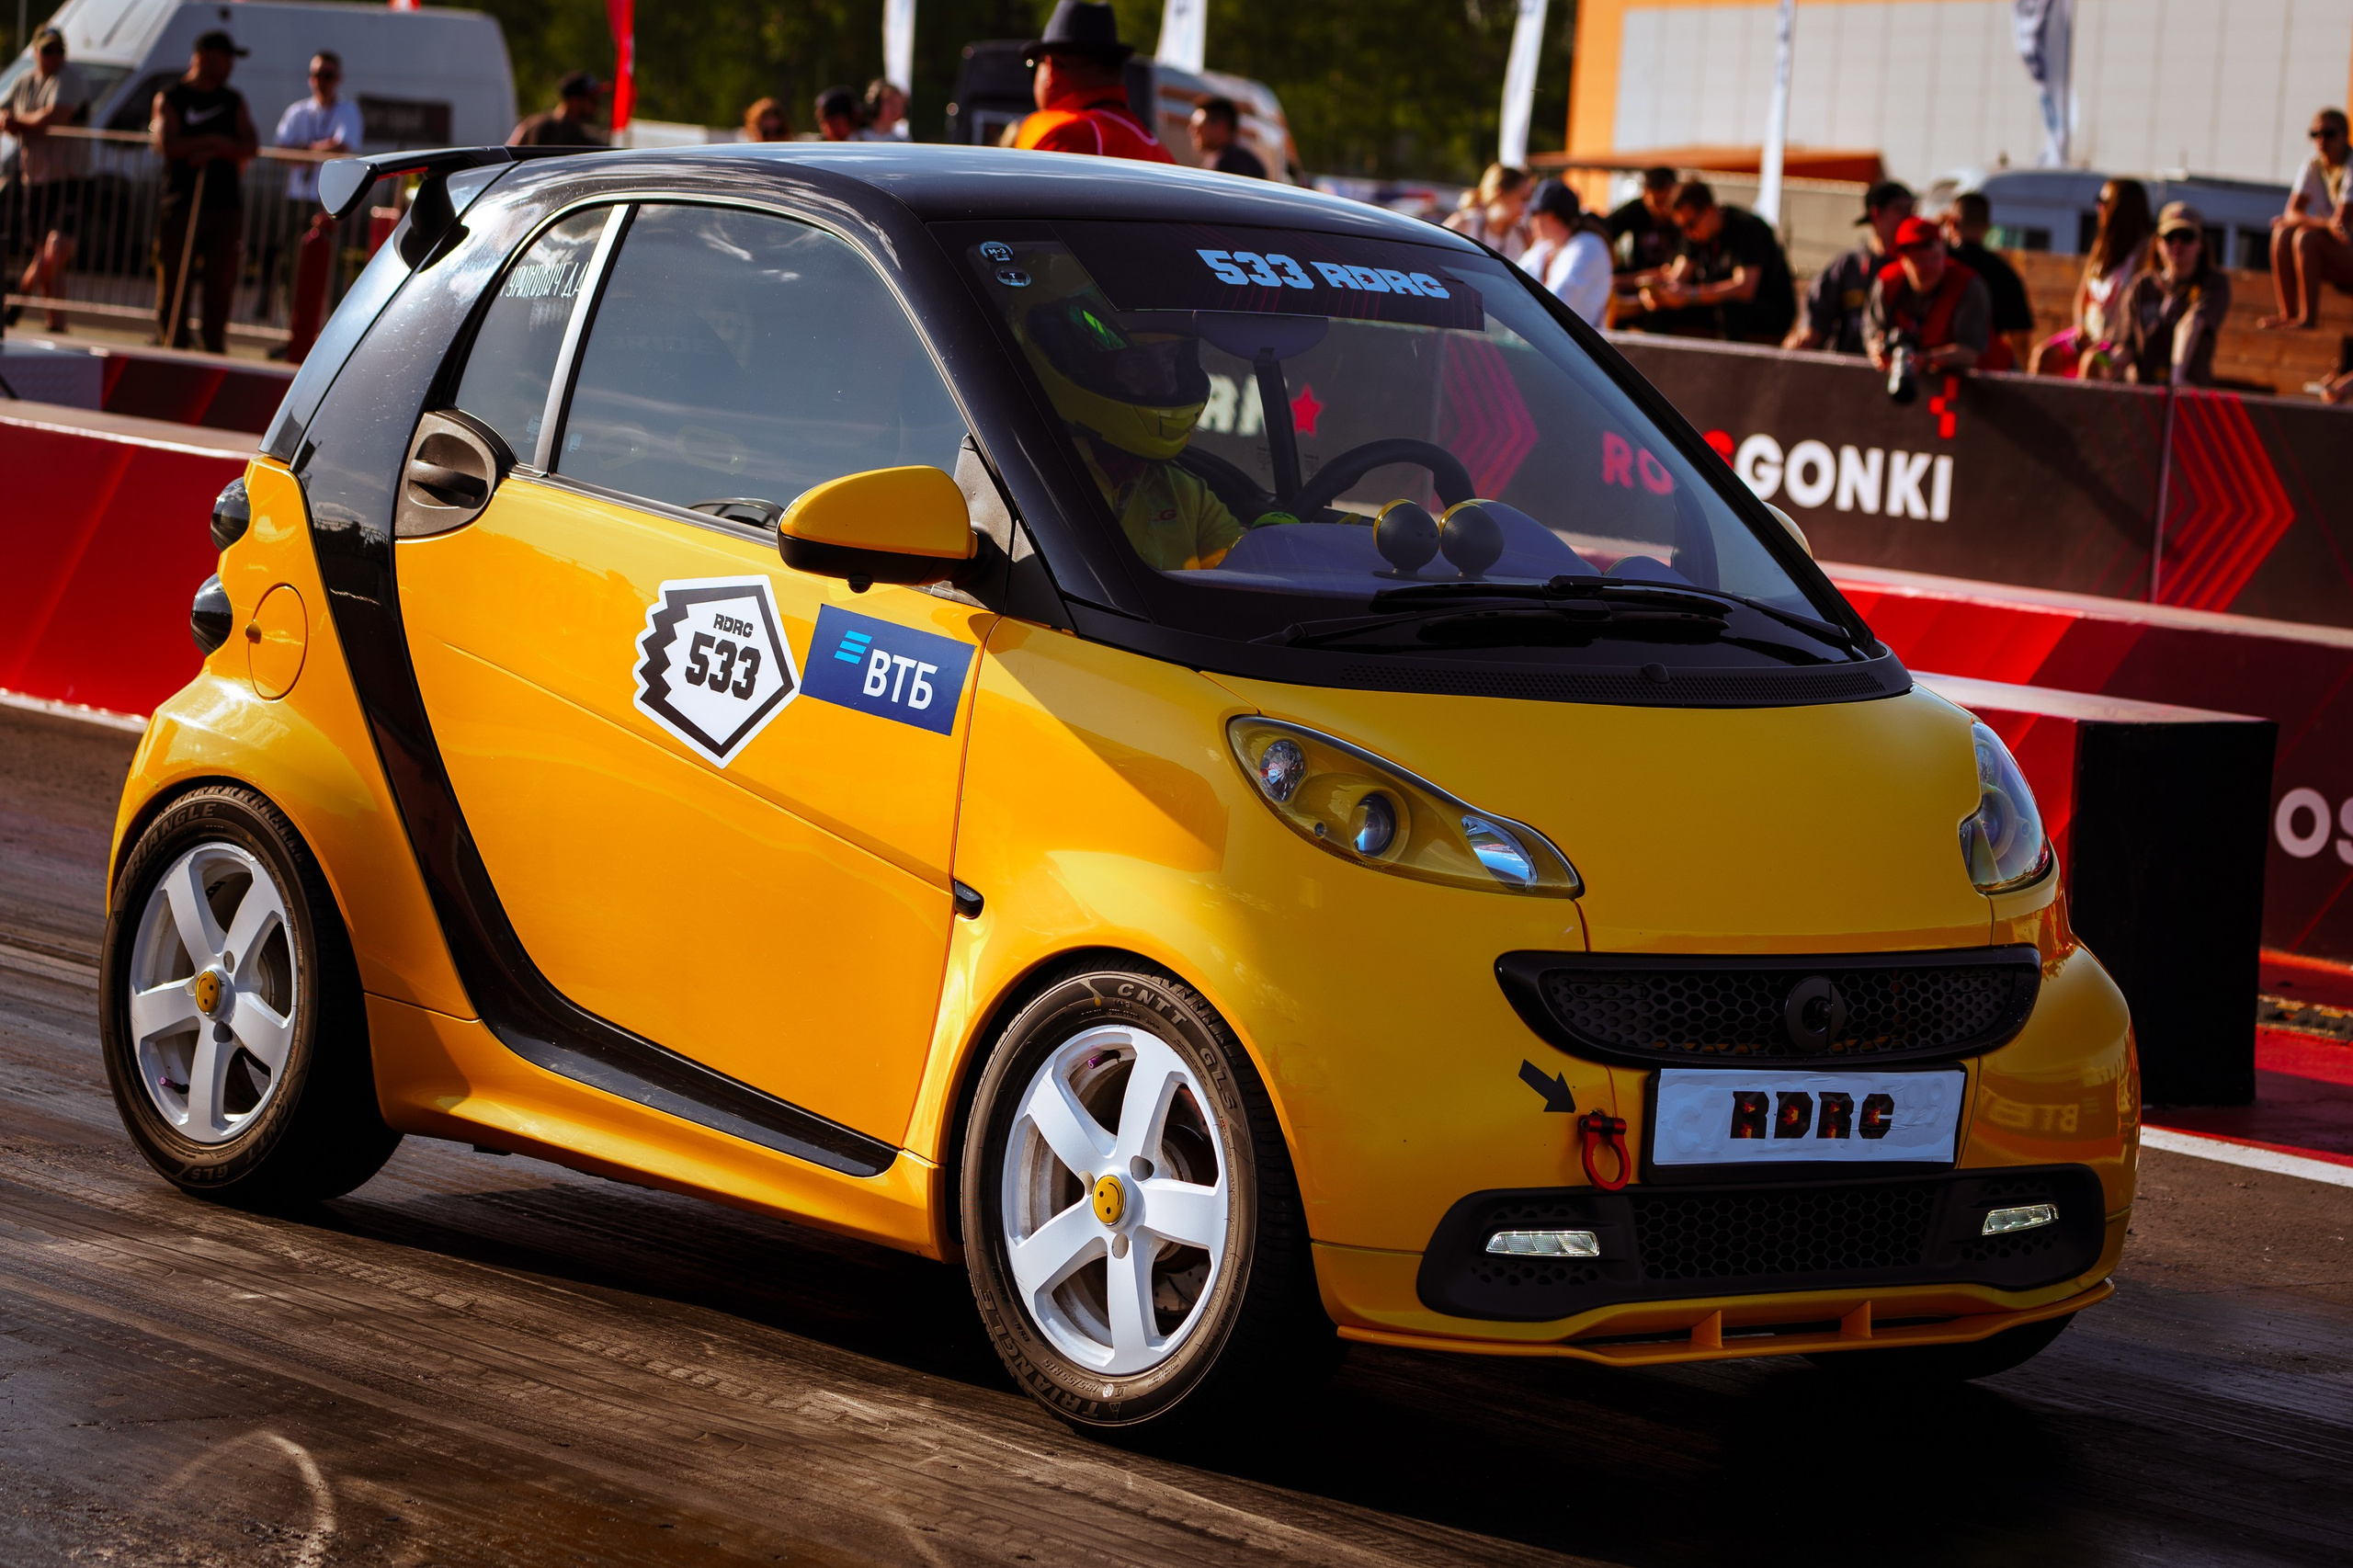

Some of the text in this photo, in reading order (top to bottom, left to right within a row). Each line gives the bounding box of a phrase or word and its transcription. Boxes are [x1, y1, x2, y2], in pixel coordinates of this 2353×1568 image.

[1196, 249, 1450, 299] 533 RDRC
[600, 335, 719, 356] BRIDE
[712, 613, 754, 638] RDRC
[685, 631, 762, 701] 533
[862, 648, 938, 710] ВТБ
[119, 802, 218, 899] TRIANGLE
[1117, 983, 1189, 1026] CNTT
[1199, 1047, 1237, 1110] GLS
[1730, 1091, 1895, 1139] RDRC
[190, 1164, 229, 1181] GLS
[977, 1289, 1099, 1418] TRIANGLE
